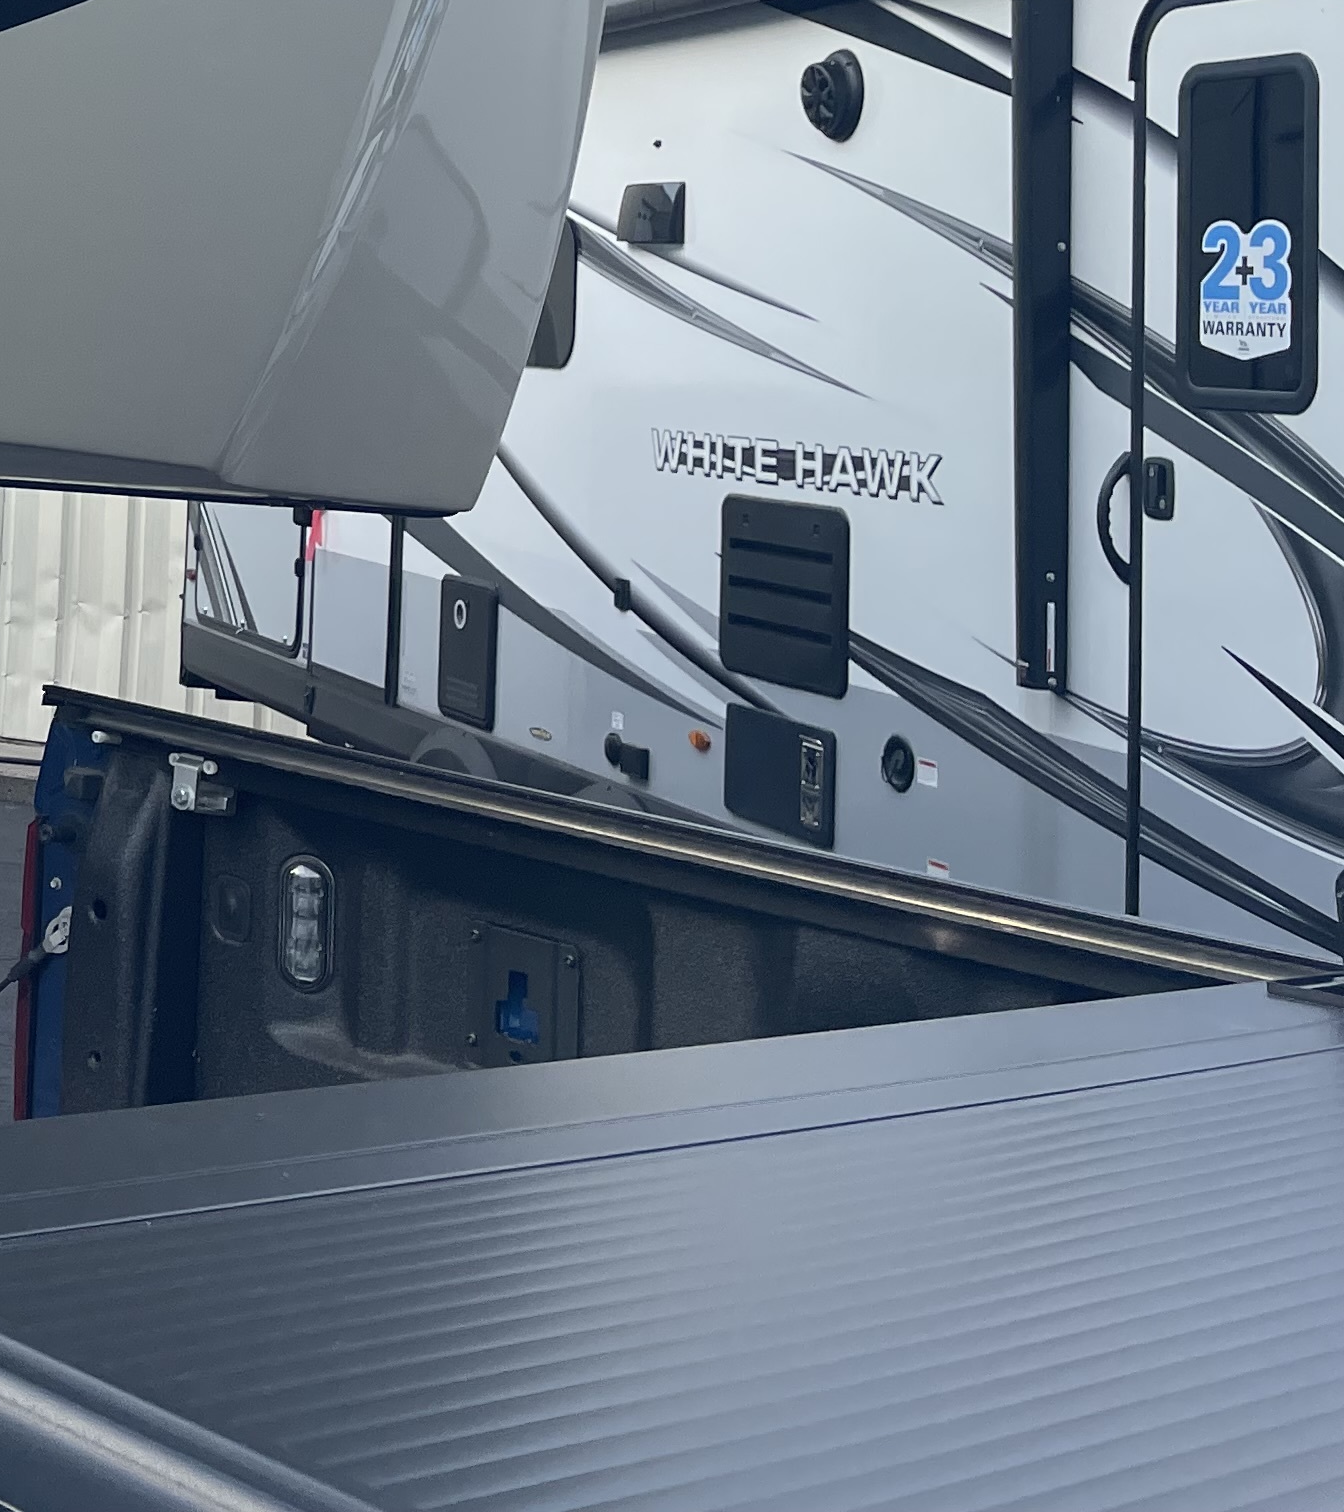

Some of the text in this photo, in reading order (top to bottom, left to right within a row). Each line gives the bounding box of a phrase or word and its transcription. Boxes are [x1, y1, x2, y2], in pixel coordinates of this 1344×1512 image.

[1203, 301, 1287, 315] YEAR YEAR
[1203, 320, 1287, 338] WARRANTY
[651, 428, 945, 506] WHITE HAWK
